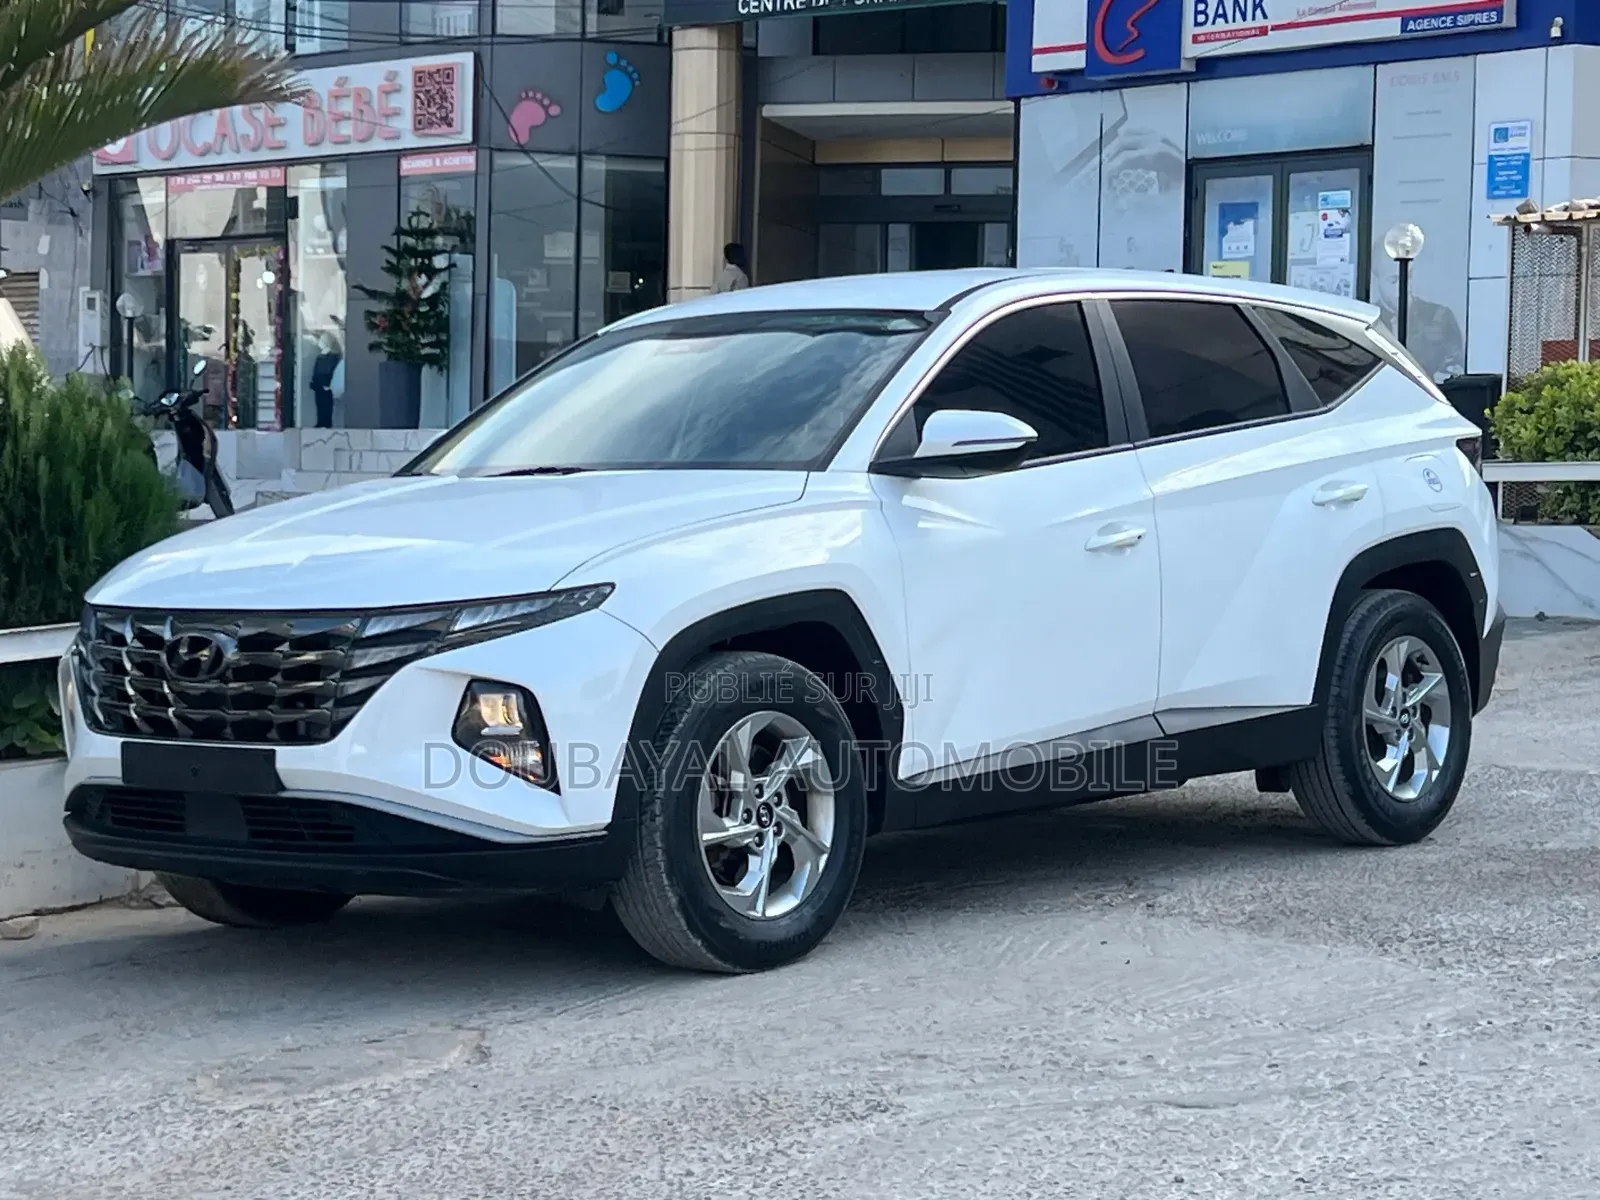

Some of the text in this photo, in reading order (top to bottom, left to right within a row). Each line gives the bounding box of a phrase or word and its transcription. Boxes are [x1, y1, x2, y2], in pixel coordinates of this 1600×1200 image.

[1194, 0, 1268, 27] BANK
[1406, 11, 1498, 31] AGENCE SIPRES
[302, 69, 403, 147] BÉBÉ
